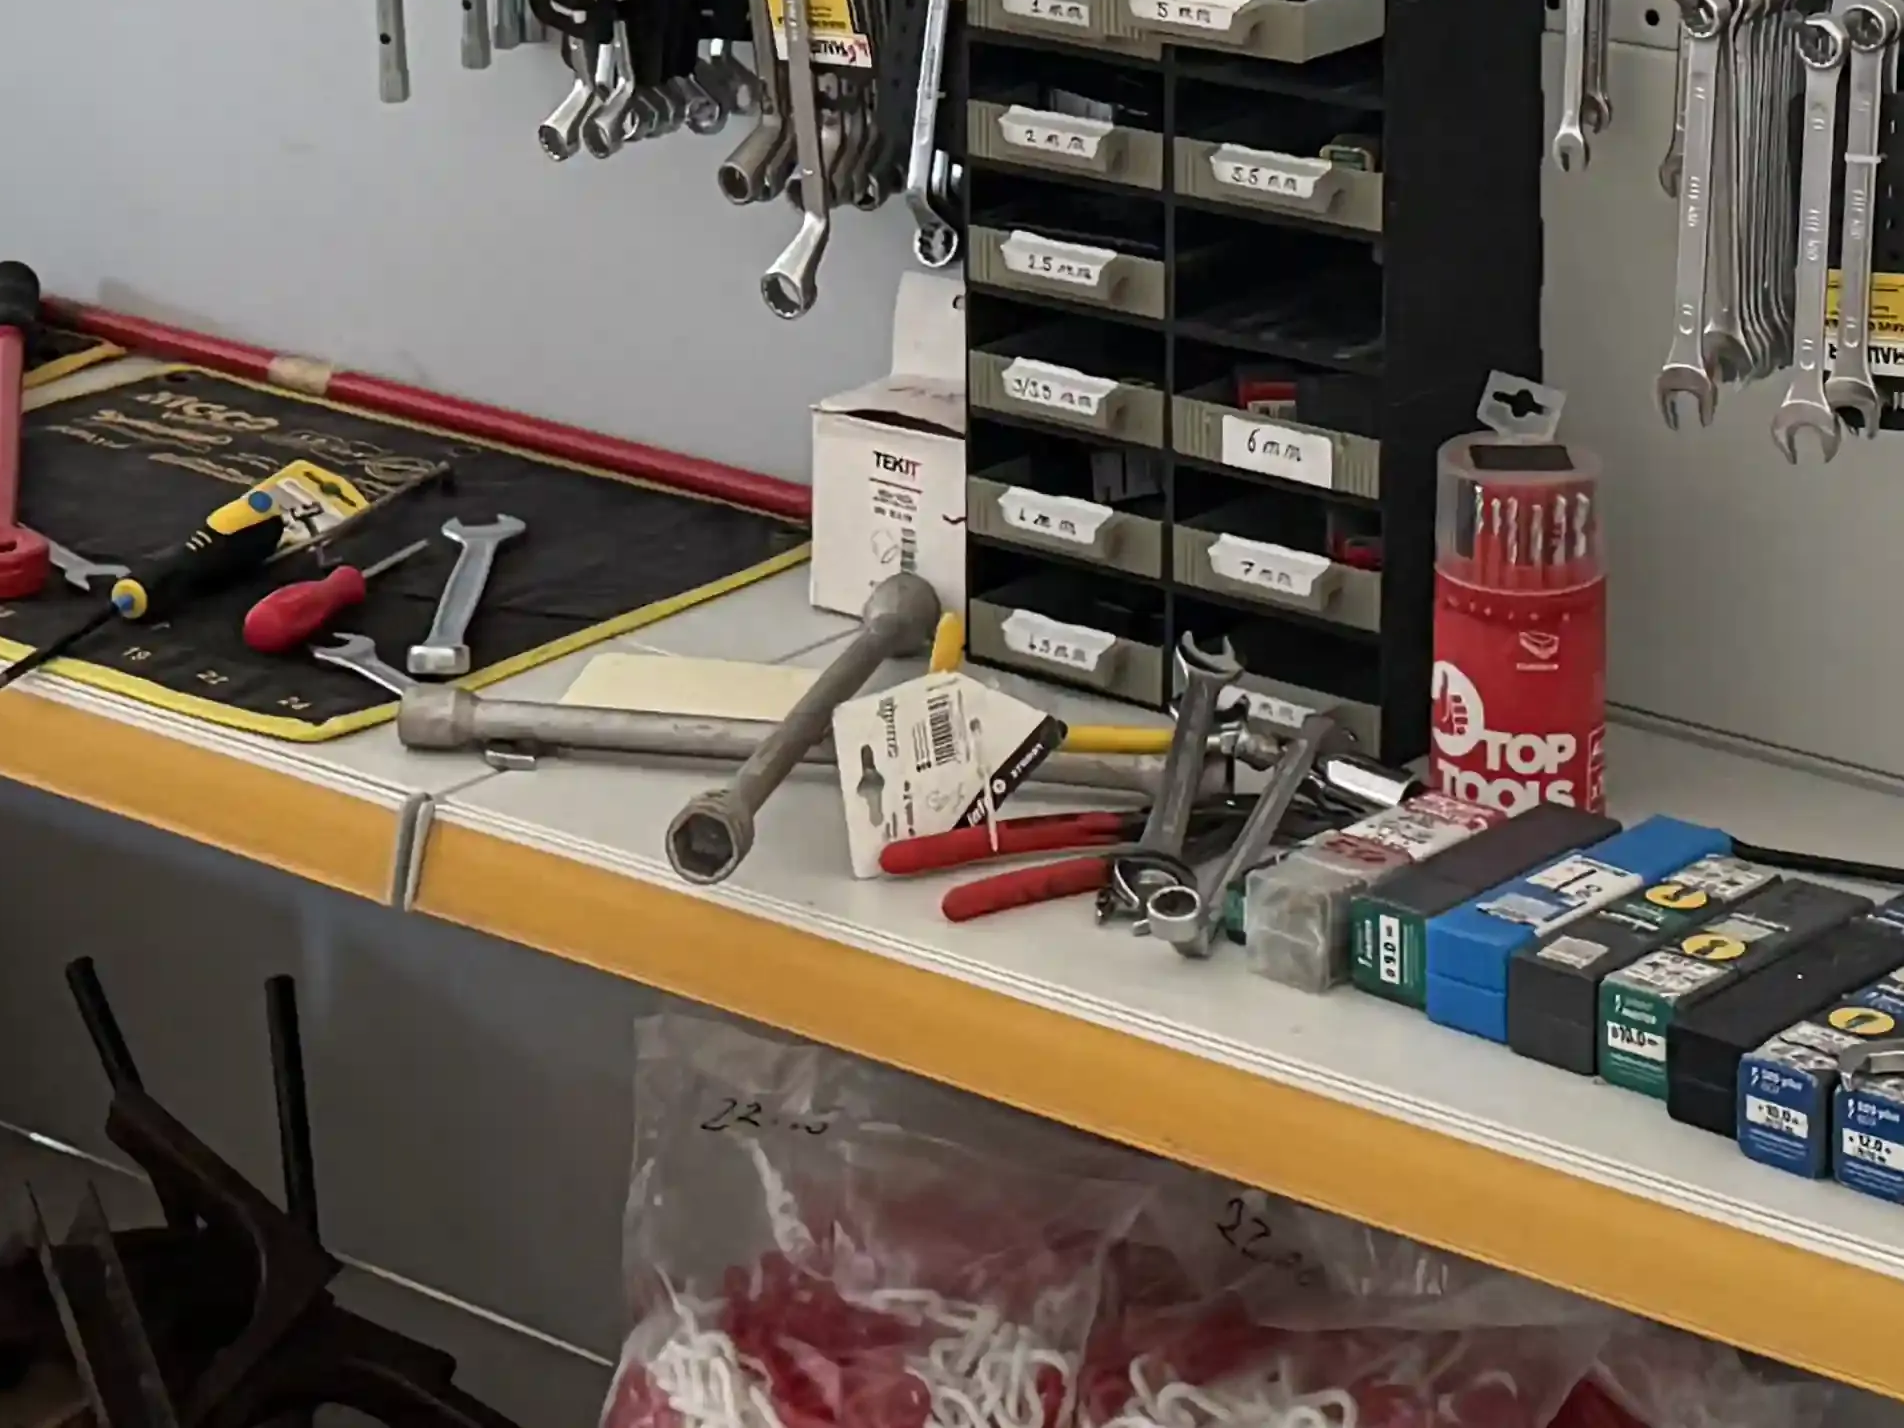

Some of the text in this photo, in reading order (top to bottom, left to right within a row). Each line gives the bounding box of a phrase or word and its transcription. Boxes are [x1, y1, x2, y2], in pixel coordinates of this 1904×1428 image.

[872, 449, 923, 478] TEKIT
[1246, 427, 1302, 463] 6 mm
[1484, 732, 1577, 774] TOP
[1437, 757, 1577, 818] TOOLS
